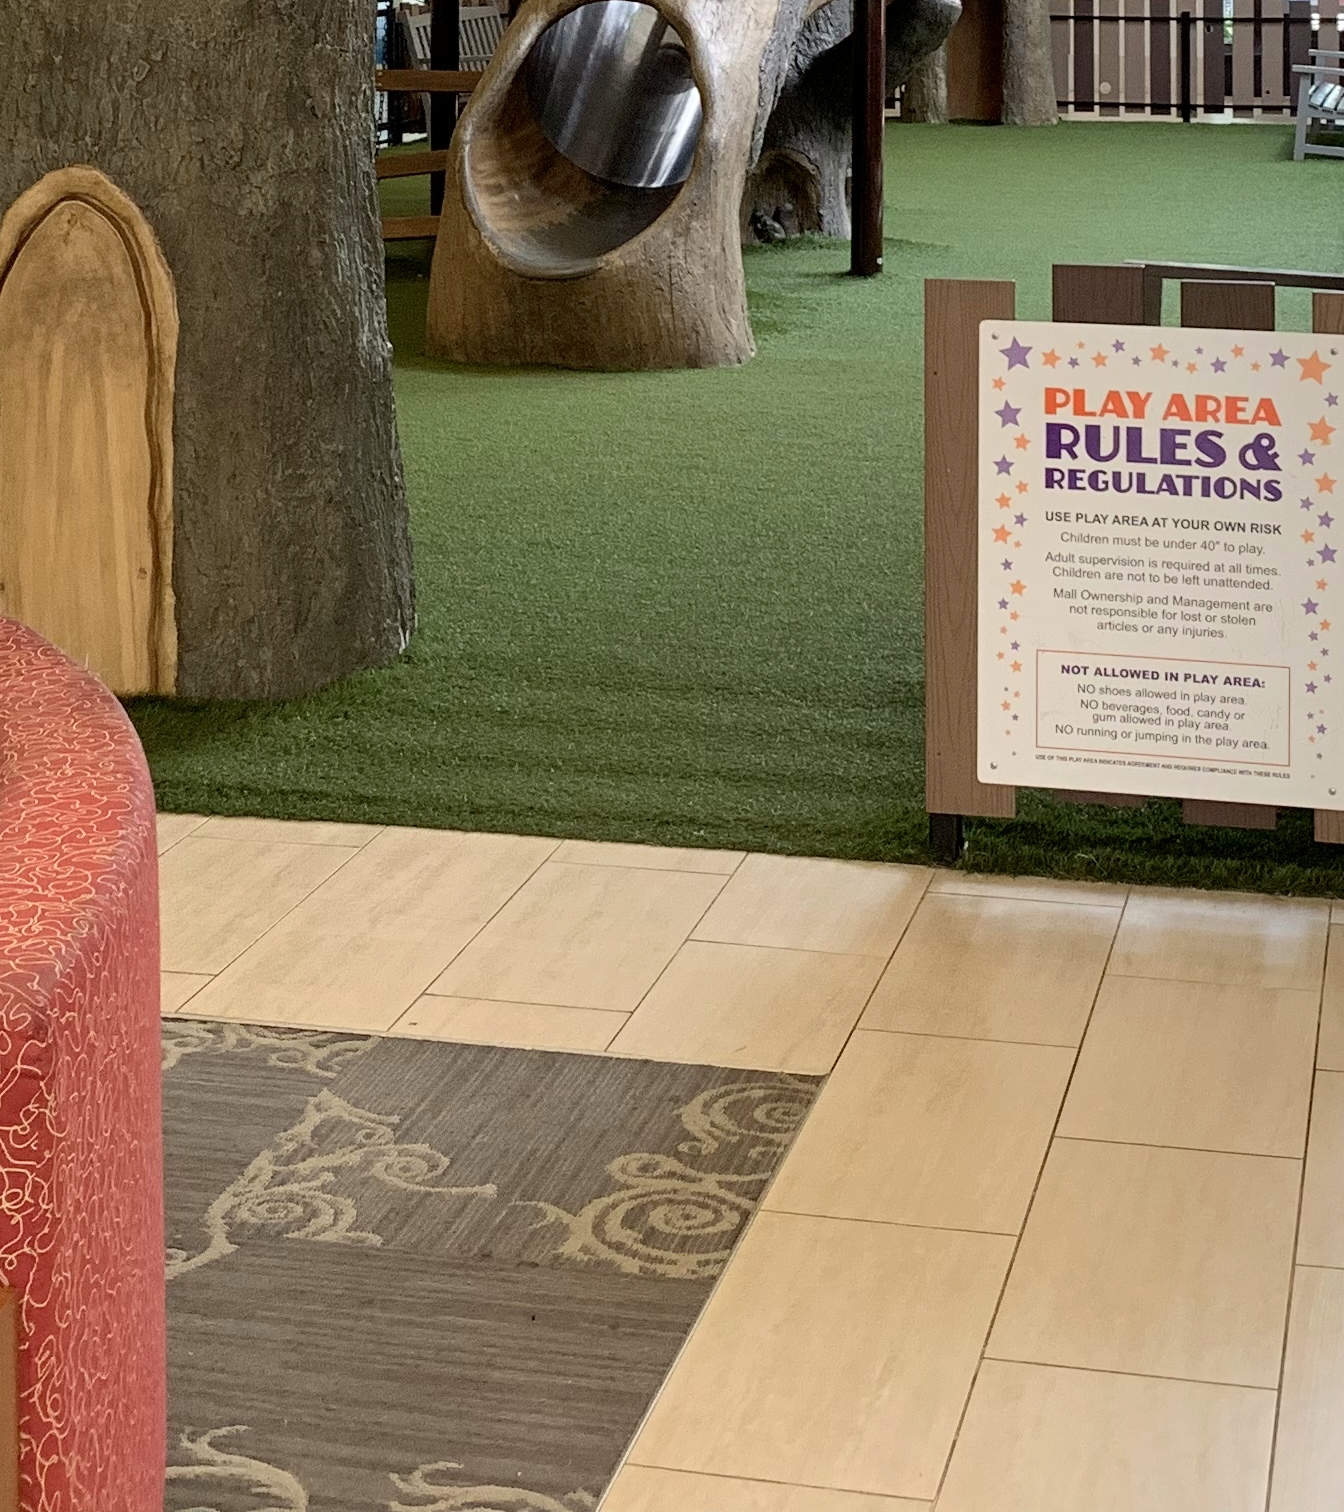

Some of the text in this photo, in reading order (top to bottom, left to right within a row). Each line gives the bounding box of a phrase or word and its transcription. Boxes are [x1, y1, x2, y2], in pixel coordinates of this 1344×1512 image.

[1044, 387, 1283, 427] PLAY AREA
[1045, 422, 1283, 472] RULES &
[1044, 467, 1283, 502] REGULATIONS
[1045, 510, 1282, 535] USE PLAY AREA AT YOUR OWN RISK
[1060, 531, 1109, 545] Children
[1113, 536, 1141, 547] must
[1145, 537, 1159, 548] be
[1163, 539, 1197, 550] under
[1223, 542, 1235, 553] to
[1238, 543, 1265, 556] play.
[1045, 551, 1075, 563] Adult
[1078, 554, 1145, 568] supervision
[1148, 557, 1158, 568] is
[1161, 560, 1210, 572] required
[1214, 562, 1225, 573] at
[1228, 563, 1242, 574] all
[1052, 566, 1101, 579] Children
[1104, 572, 1123, 580] are
[1127, 572, 1146, 582] not
[1149, 573, 1160, 583] to
[1163, 573, 1178, 584] be
[1182, 574, 1200, 585] left
[1053, 588, 1273, 612] Mall Ownership and Management are
[1069, 604, 1256, 625] not responsible for lost or stolen
[1096, 621, 1139, 633] articles
[1141, 624, 1154, 634] or
[1157, 626, 1178, 637] any
[1061, 664, 1266, 688] NOT ALLOWED IN PLAY AREA:
[1077, 683, 1095, 694] NO
[1098, 685, 1132, 697] shoes
[1135, 688, 1177, 700] allowed
[1180, 691, 1190, 701] in
[1193, 692, 1216, 705] play
[1080, 699, 1098, 709] NO
[1102, 701, 1163, 715] beverages,
[1197, 709, 1231, 721] candy
[1233, 711, 1245, 720] or
[1092, 713, 1116, 723] gum
[1119, 715, 1161, 726] allowed
[1164, 717, 1174, 727] in
[1177, 718, 1201, 731] play
[1055, 724, 1074, 735] NO
[1077, 727, 1117, 740] running
[1120, 730, 1133, 739] or
[1135, 729, 1178, 744] jumping
[1182, 733, 1191, 743] in
[1195, 734, 1212, 745] the
[1216, 736, 1239, 749] play
[1173, 764, 1201, 772] REQUIRES
[1202, 766, 1237, 775] COMPLIANCE
